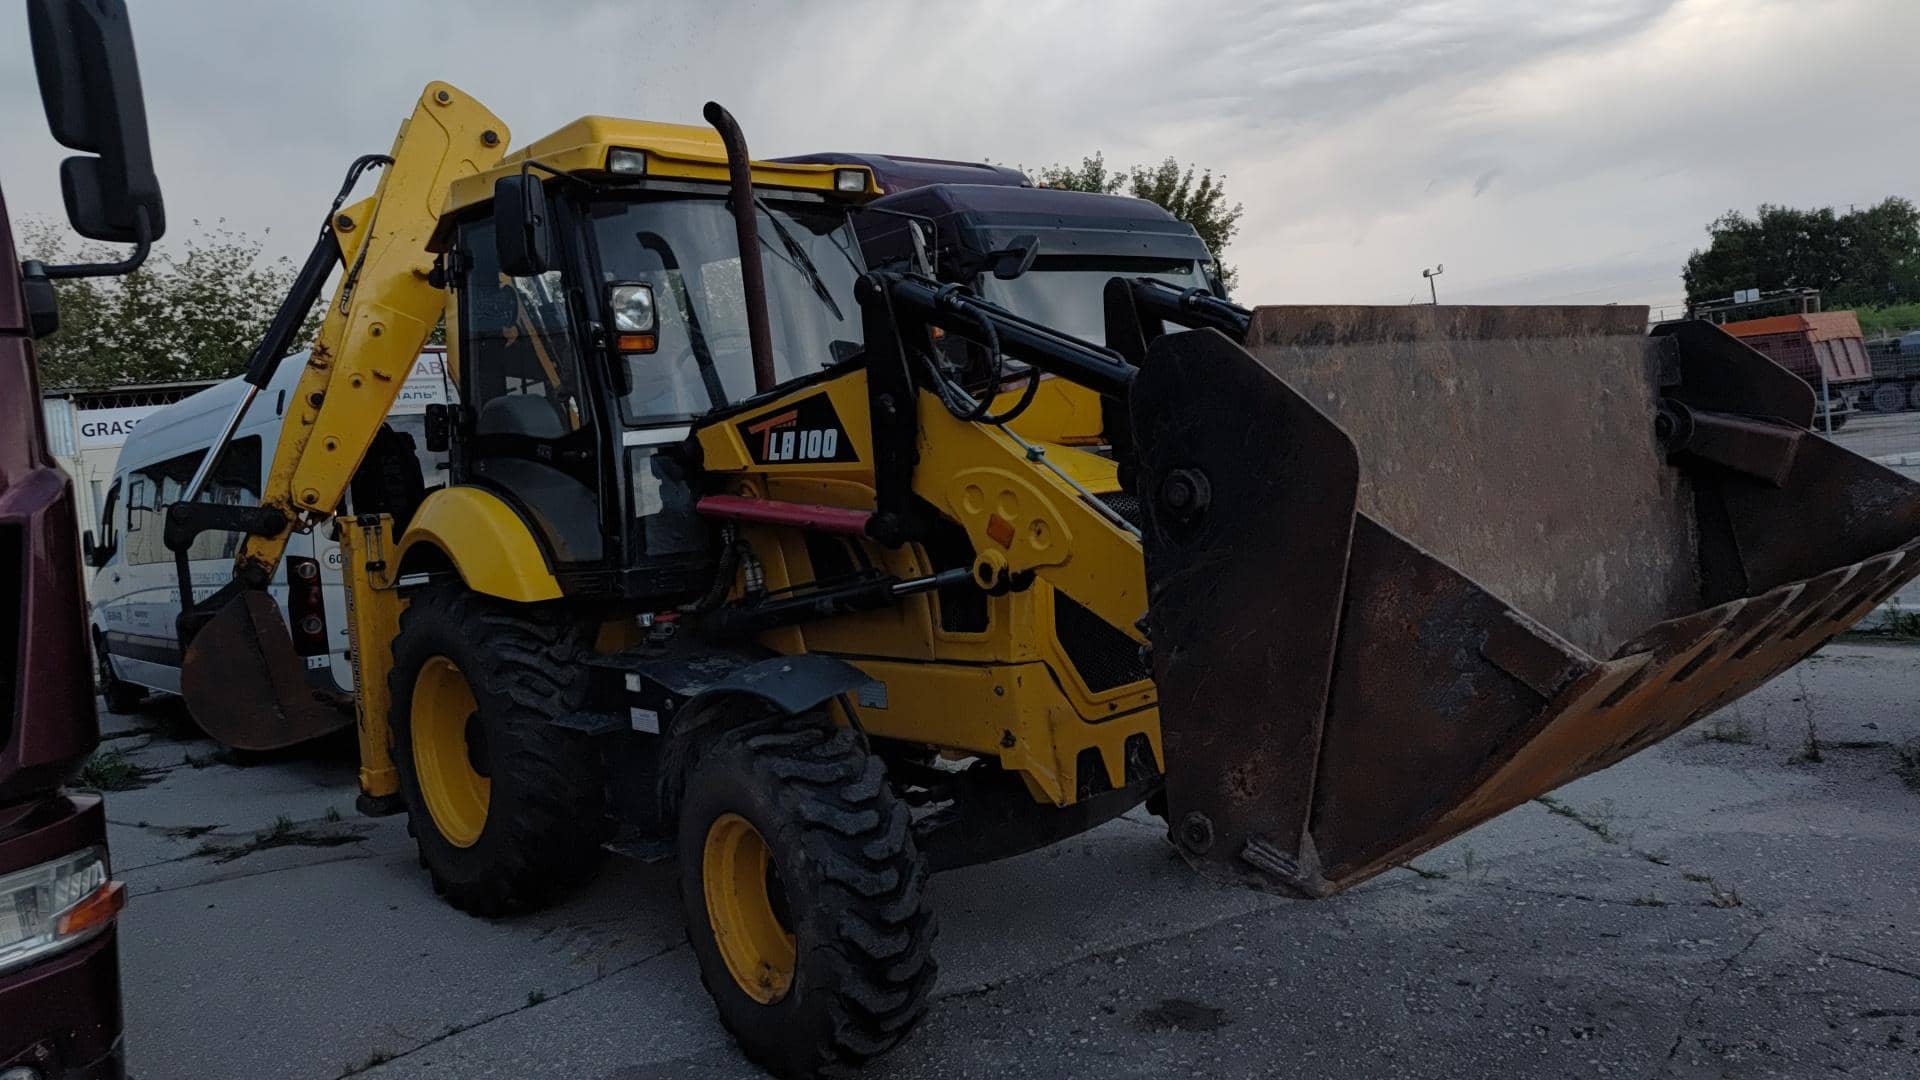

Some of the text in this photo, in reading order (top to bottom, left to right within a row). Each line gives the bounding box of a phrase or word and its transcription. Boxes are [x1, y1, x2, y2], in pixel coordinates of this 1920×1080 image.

[415, 361, 446, 376] АВ
[396, 391, 437, 400] АЛЬ"
[81, 419, 141, 437] GRAS
[748, 408, 838, 461] TLB 100
